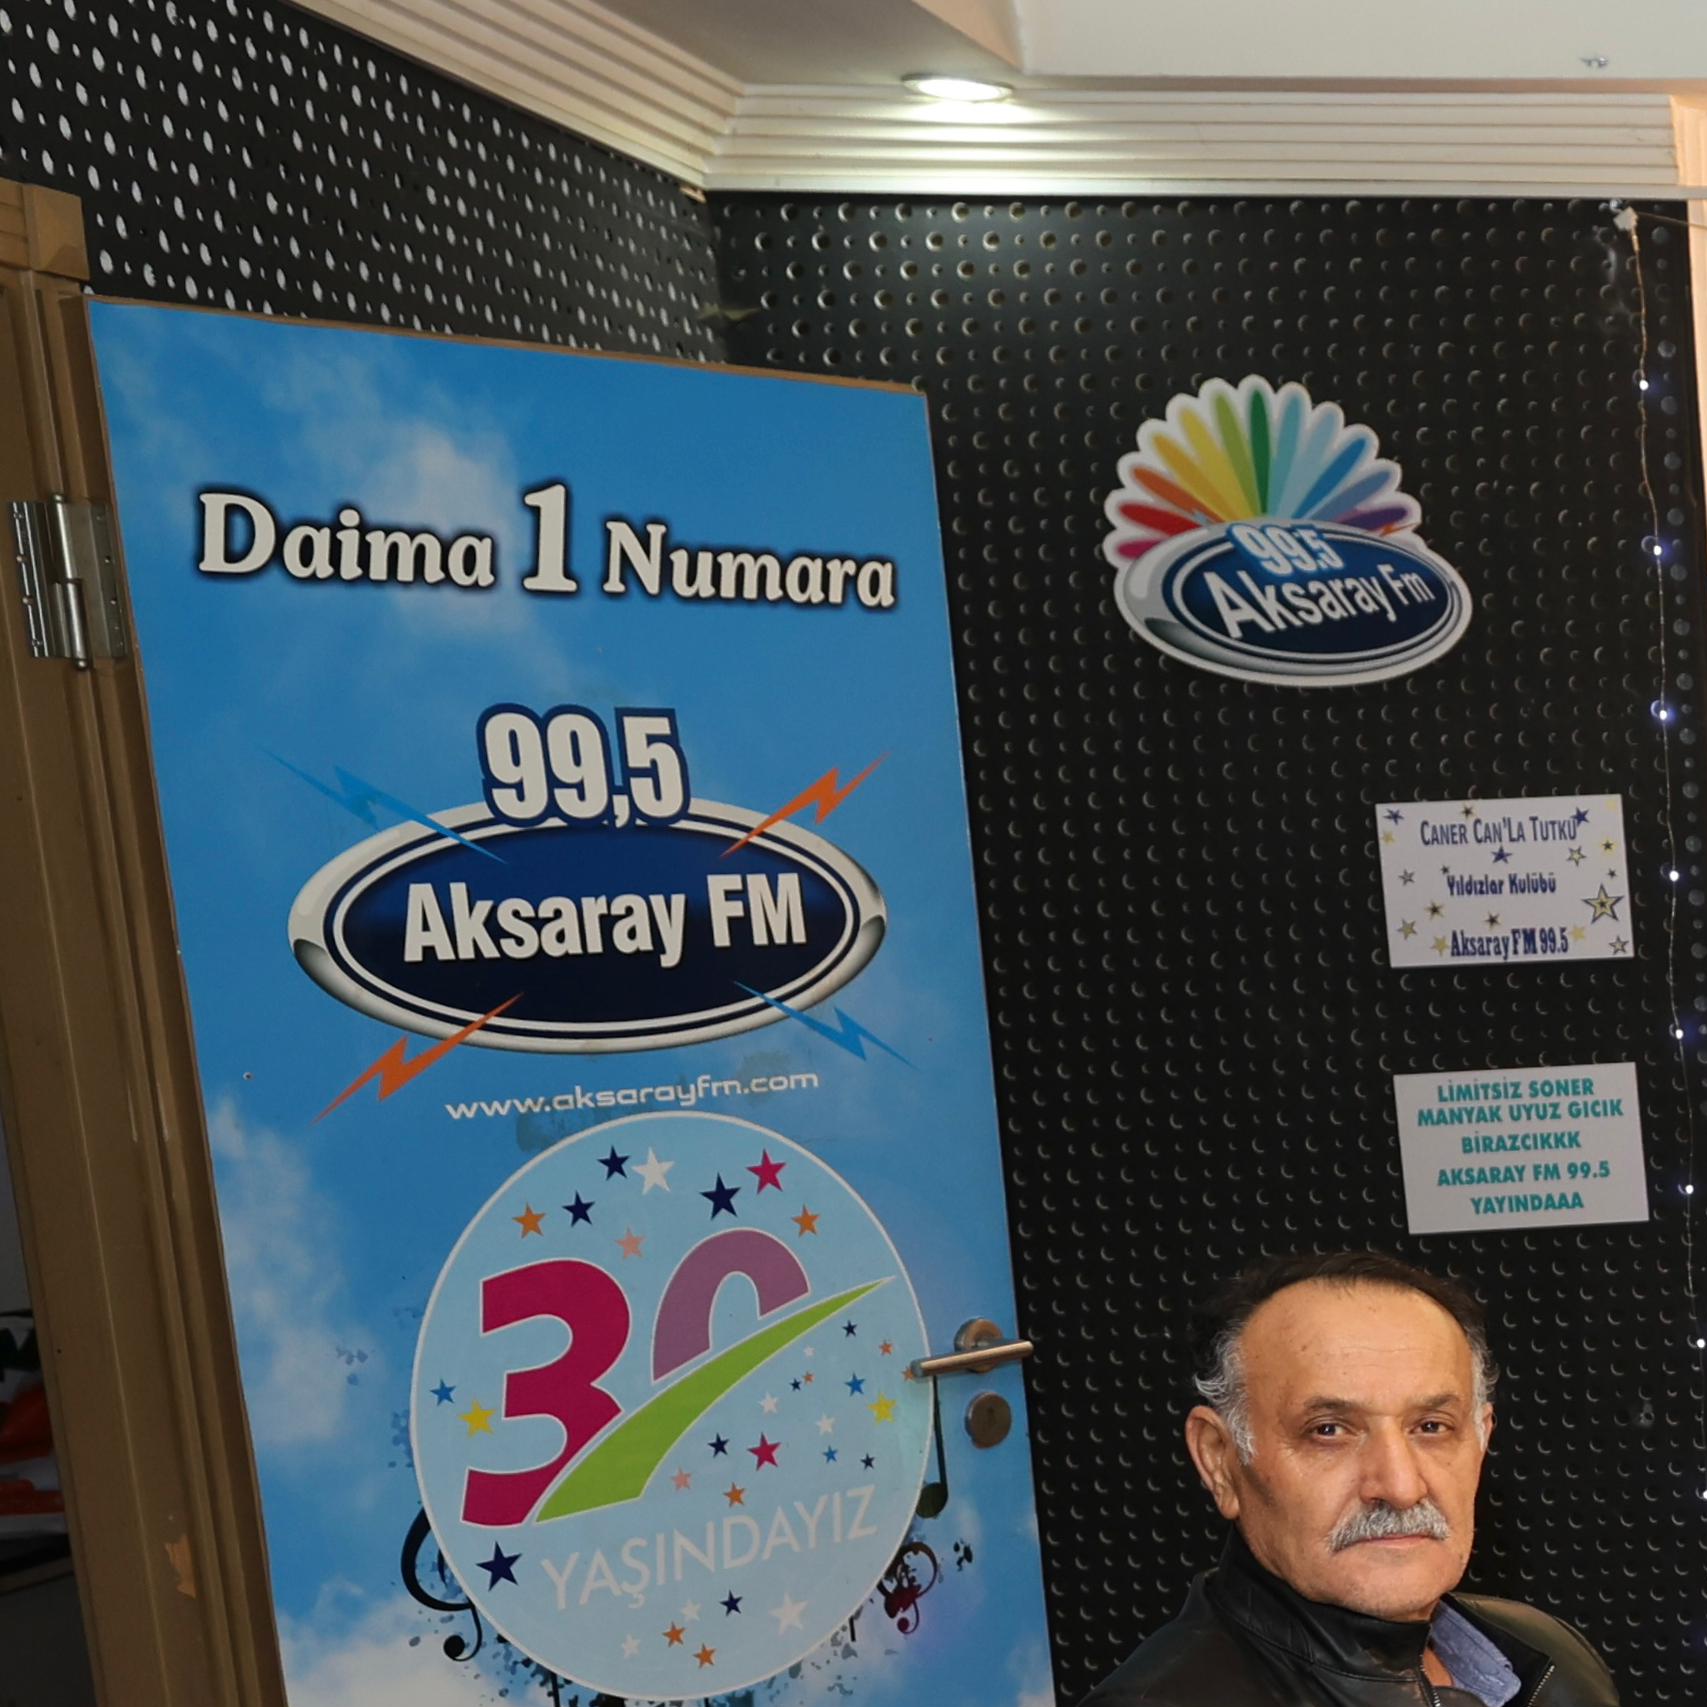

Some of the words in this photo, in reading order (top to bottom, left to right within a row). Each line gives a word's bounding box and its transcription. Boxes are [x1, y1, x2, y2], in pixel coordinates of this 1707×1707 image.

[199, 491, 494, 588] Daima
[524, 484, 578, 592] 1
[604, 521, 895, 608] Numara
[1203, 570, 1397, 639] Aksaray
[1376, 563, 1436, 605] Fm
[481, 709, 688, 826] 99,5
[1509, 872, 1556, 894] Kulübü
[403, 881, 686, 967] Aksaray
[708, 873, 806, 947] FM
[1451, 930, 1510, 960] Aksaray
[1512, 928, 1537, 955] FM
[1540, 927, 1569, 954] 99.5
[445, 1070, 819, 1120] www.aksarayfm.com
[1529, 1078, 1594, 1097] SONER
[1418, 1107, 1502, 1127] MANYAK
[1509, 1102, 1561, 1121] UYUZ
[1567, 1099, 1623, 1119] GICIK
[1462, 1131, 1581, 1154] BİRAZCIKKK
[1437, 1165, 1525, 1186] AKSARAY
[1533, 1163, 1561, 1181] FM
[1566, 1161, 1611, 1179] 99.5
[1471, 1192, 1584, 1215] YAYINDAAA
[461, 1227, 810, 1528] 30
[541, 1484, 878, 1611] YAŞINDAYIZ
